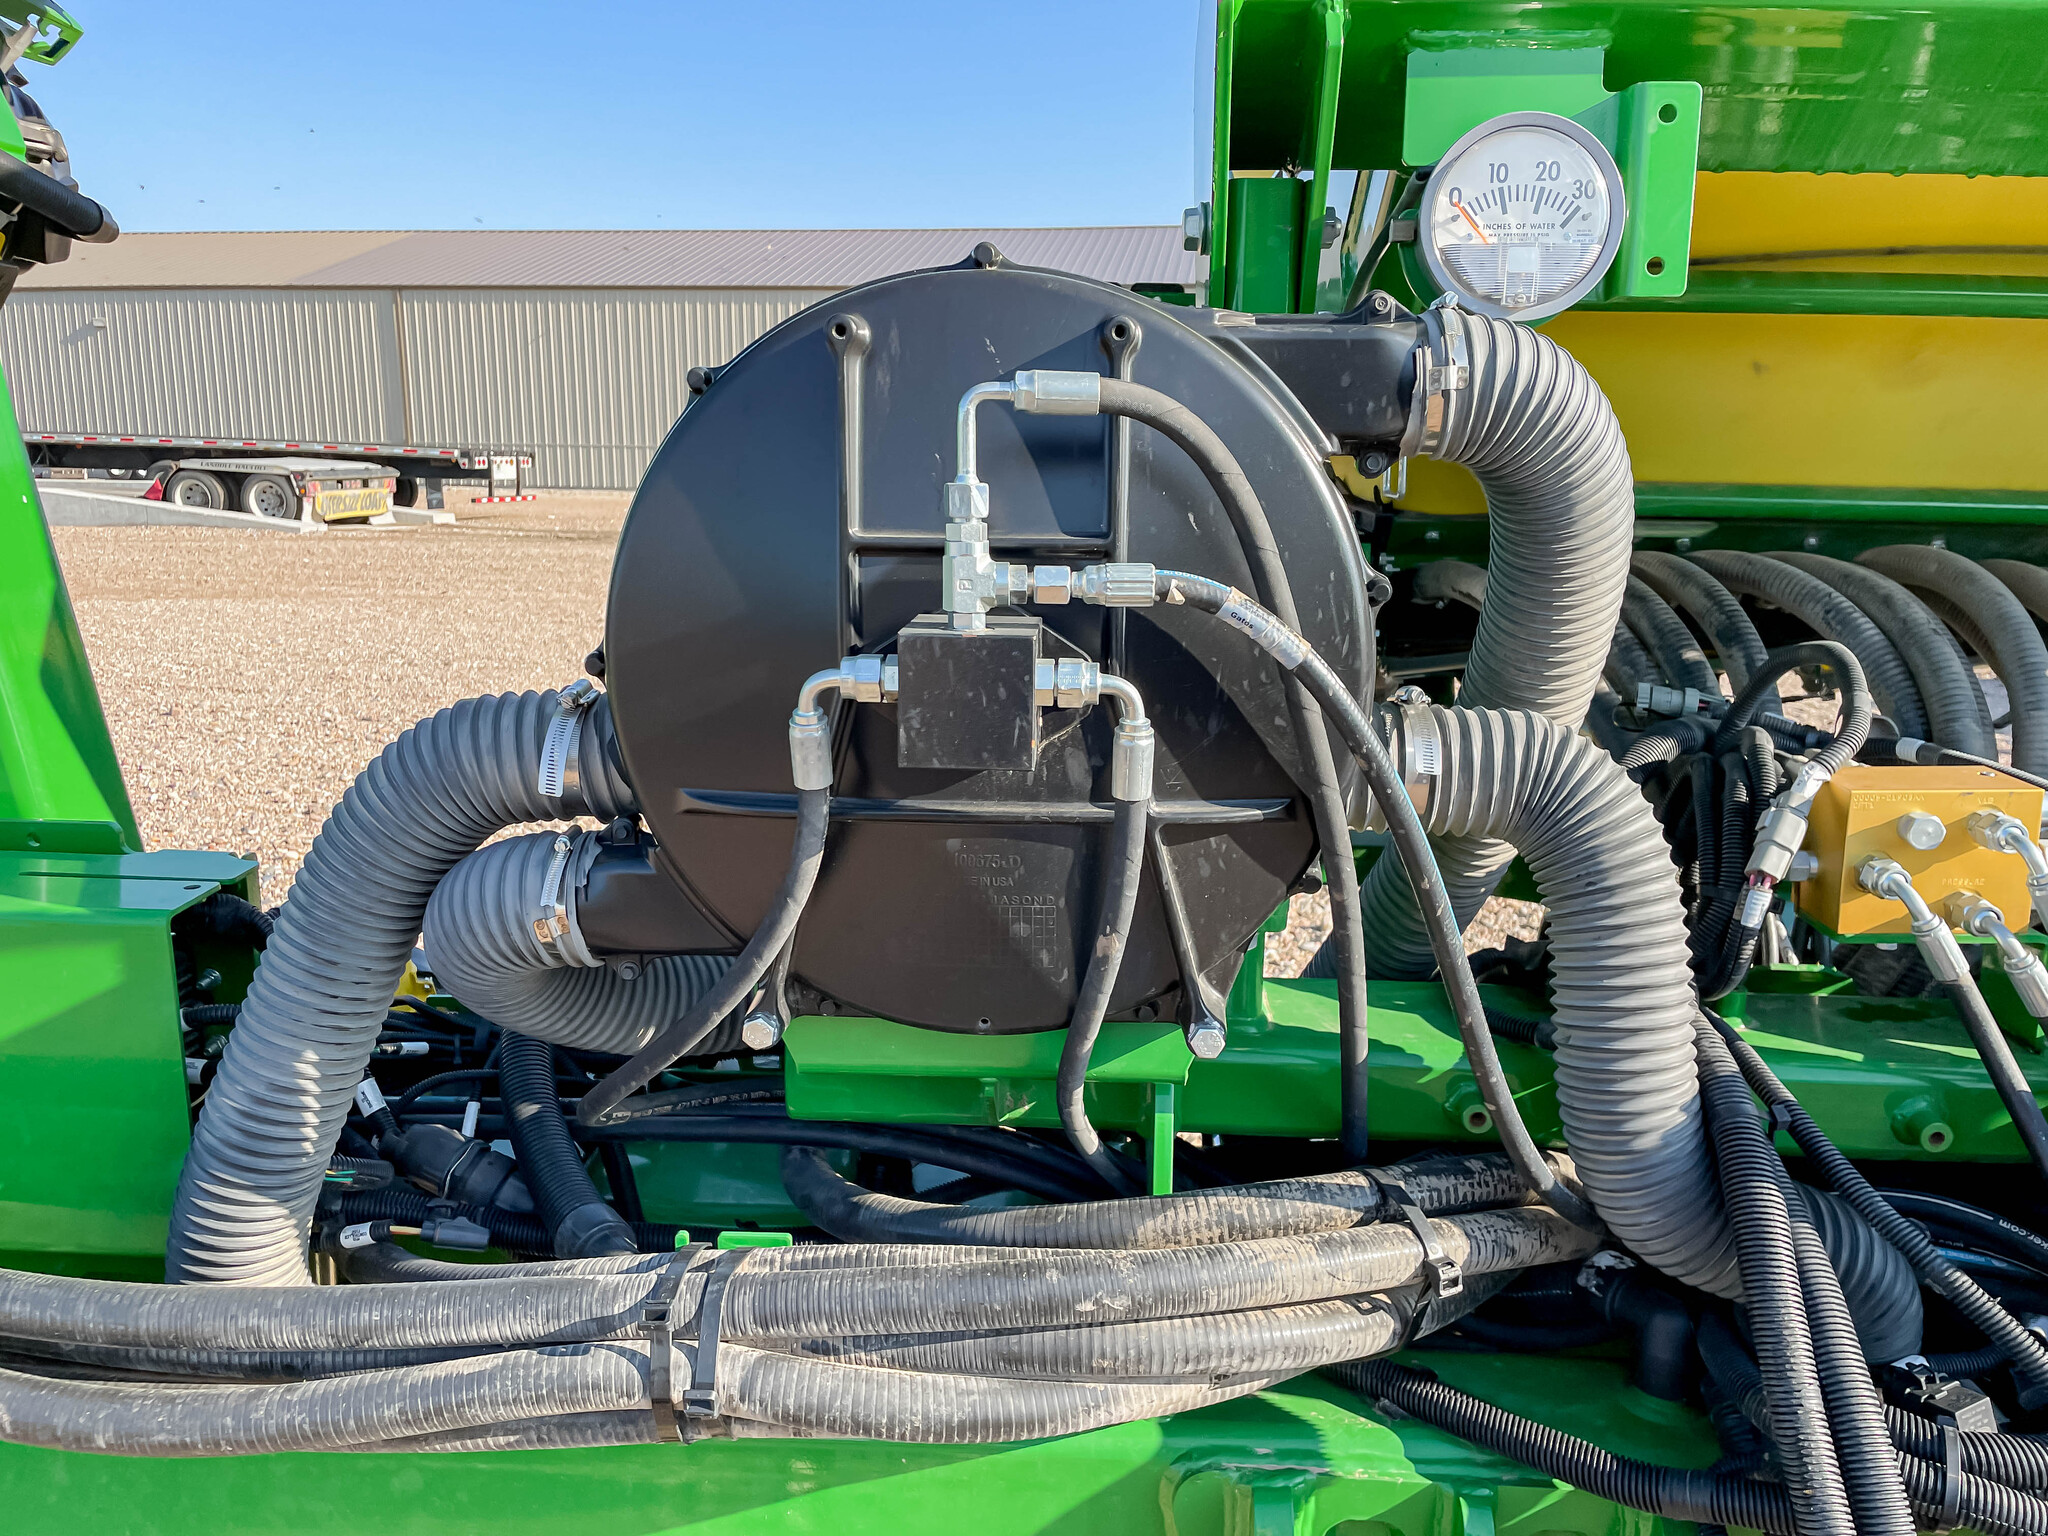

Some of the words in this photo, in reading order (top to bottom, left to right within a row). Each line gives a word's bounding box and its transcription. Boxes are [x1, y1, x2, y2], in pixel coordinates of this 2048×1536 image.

[1489, 163, 1509, 183] 10
[1535, 161, 1561, 182] 20
[1448, 187, 1462, 207] 0
[1571, 179, 1596, 200] 30
[1530, 222, 1556, 230] WATER
[320, 493, 359, 517] OVERSIZE
[980, 876, 990, 887] IN
[992, 876, 1014, 887] USA
[1998, 1217, 2048, 1251] ker.com
